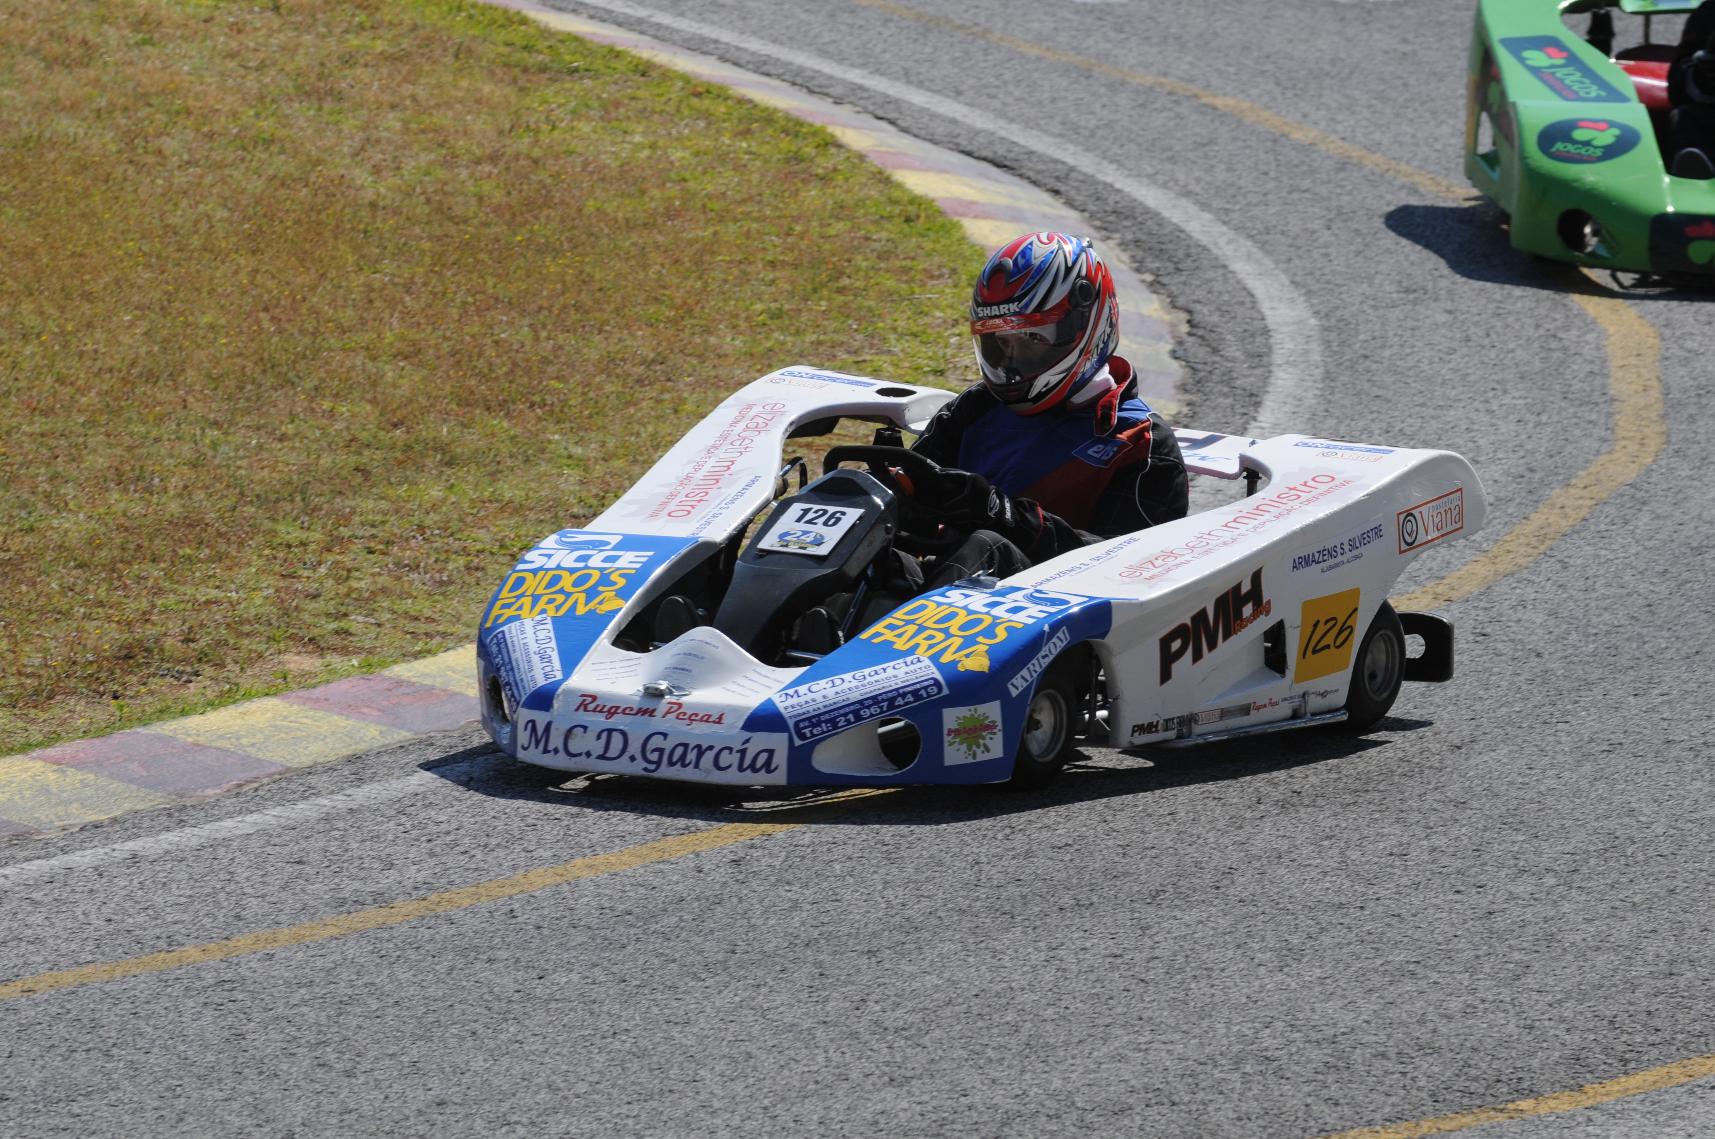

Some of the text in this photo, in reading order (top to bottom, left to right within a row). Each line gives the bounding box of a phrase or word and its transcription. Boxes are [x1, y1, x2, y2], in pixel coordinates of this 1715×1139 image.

[1550, 142, 1605, 157] JOGOS
[976, 301, 1021, 318] SHARK
[794, 506, 847, 528] 126
[1118, 473, 1337, 579] elizabethministro
[1419, 502, 1462, 537] Viana
[514, 549, 656, 571] SICCE
[1292, 545, 1339, 573] ARMAZÉNS
[1340, 542, 1347, 556] S.
[1348, 523, 1384, 553] SILVESTRE
[498, 567, 637, 599] DIDO'S
[484, 591, 618, 628] FARM
[892, 599, 1025, 645] DIDO'S
[929, 589, 1060, 625] SICCE
[1158, 566, 1265, 688] PMH
[860, 617, 990, 664] FARM
[1302, 607, 1358, 660] 126
[1009, 628, 1069, 692] VARISOM
[783, 698, 818, 712] PEÇAS
[904, 664, 931, 676] AUTO
[574, 693, 726, 727] Rugem Peças
[801, 686, 939, 738] Tel: 21 967 44 19
[1130, 719, 1161, 737] PMH
[520, 718, 781, 775] M.C.D.García
